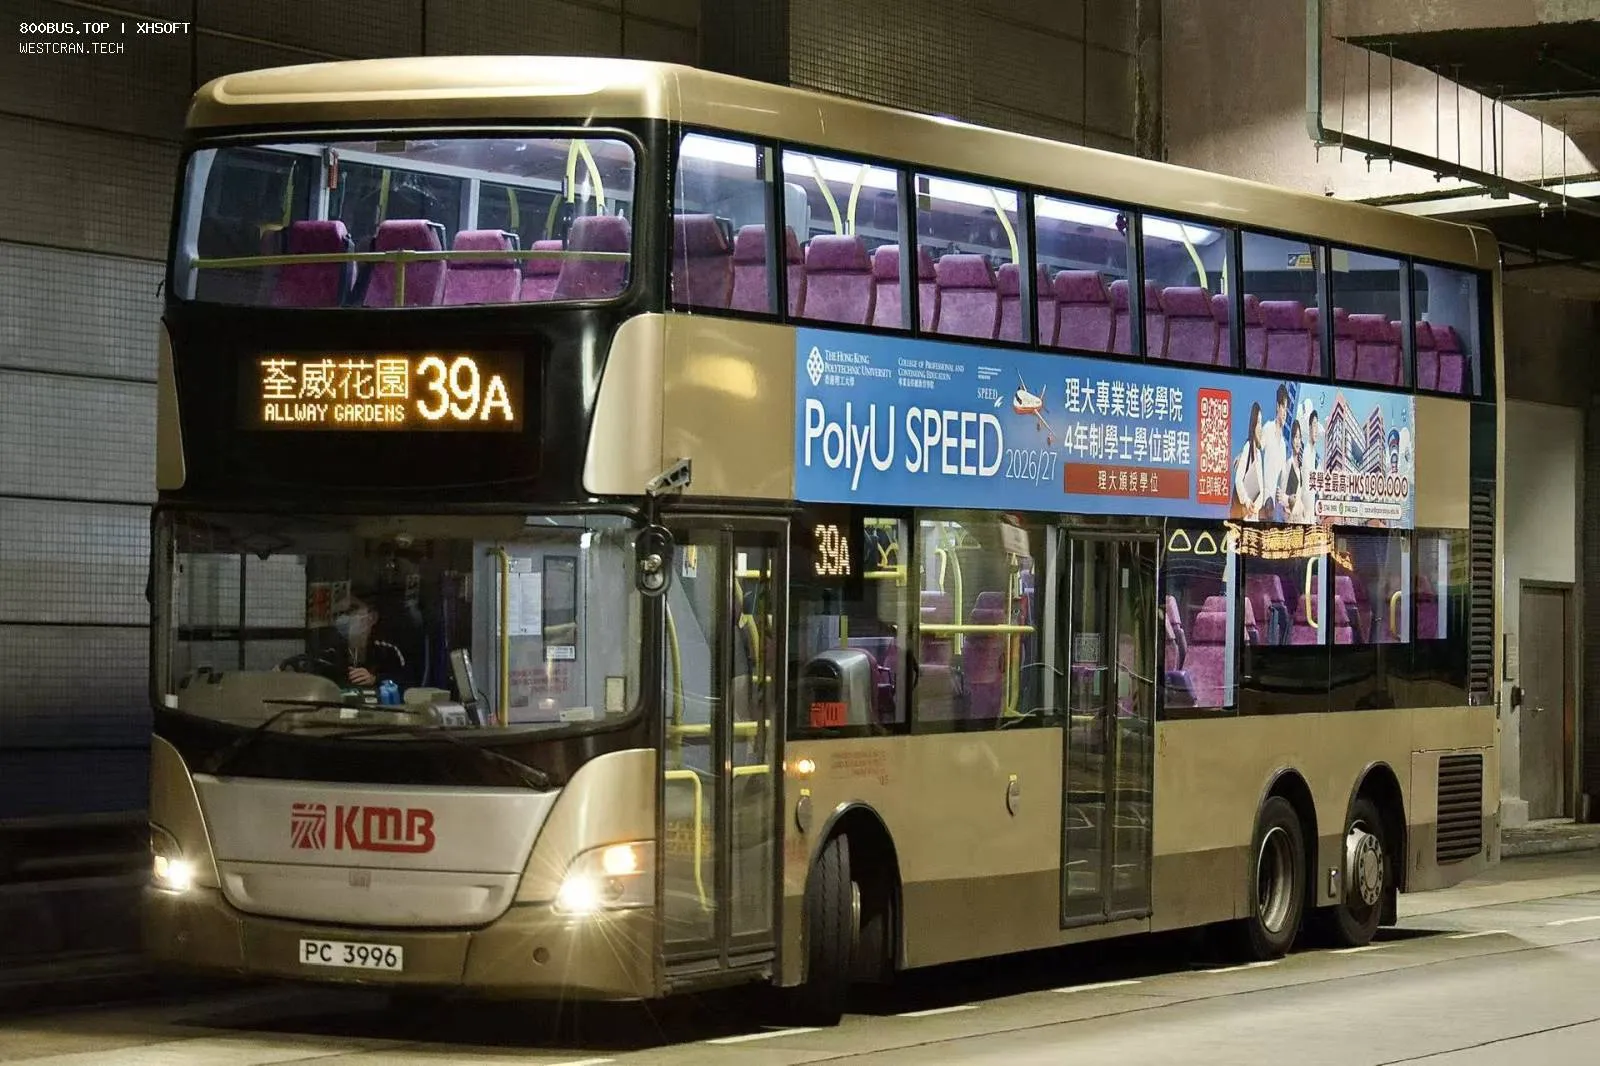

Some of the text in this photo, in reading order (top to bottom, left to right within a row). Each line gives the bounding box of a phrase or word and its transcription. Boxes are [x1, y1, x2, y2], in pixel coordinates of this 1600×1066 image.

[837, 351, 854, 363] HONG
[854, 352, 870, 364] KONG
[261, 358, 408, 399] 荃威花園
[416, 356, 515, 421] 39A
[977, 387, 998, 400] SPEED
[265, 404, 405, 422] ALLWAY GARDENS
[1065, 377, 1183, 422] 理大專業進修學院
[804, 398, 1058, 491] PolyU SPEED 2026/27
[1064, 421, 1191, 465] 4年制學士學位課程
[1098, 470, 1158, 492] 理大頒授學位
[1199, 475, 1229, 497] 立即報名
[815, 524, 851, 575] 39A
[334, 805, 436, 854] KMB
[304, 942, 398, 968] PC 3996
